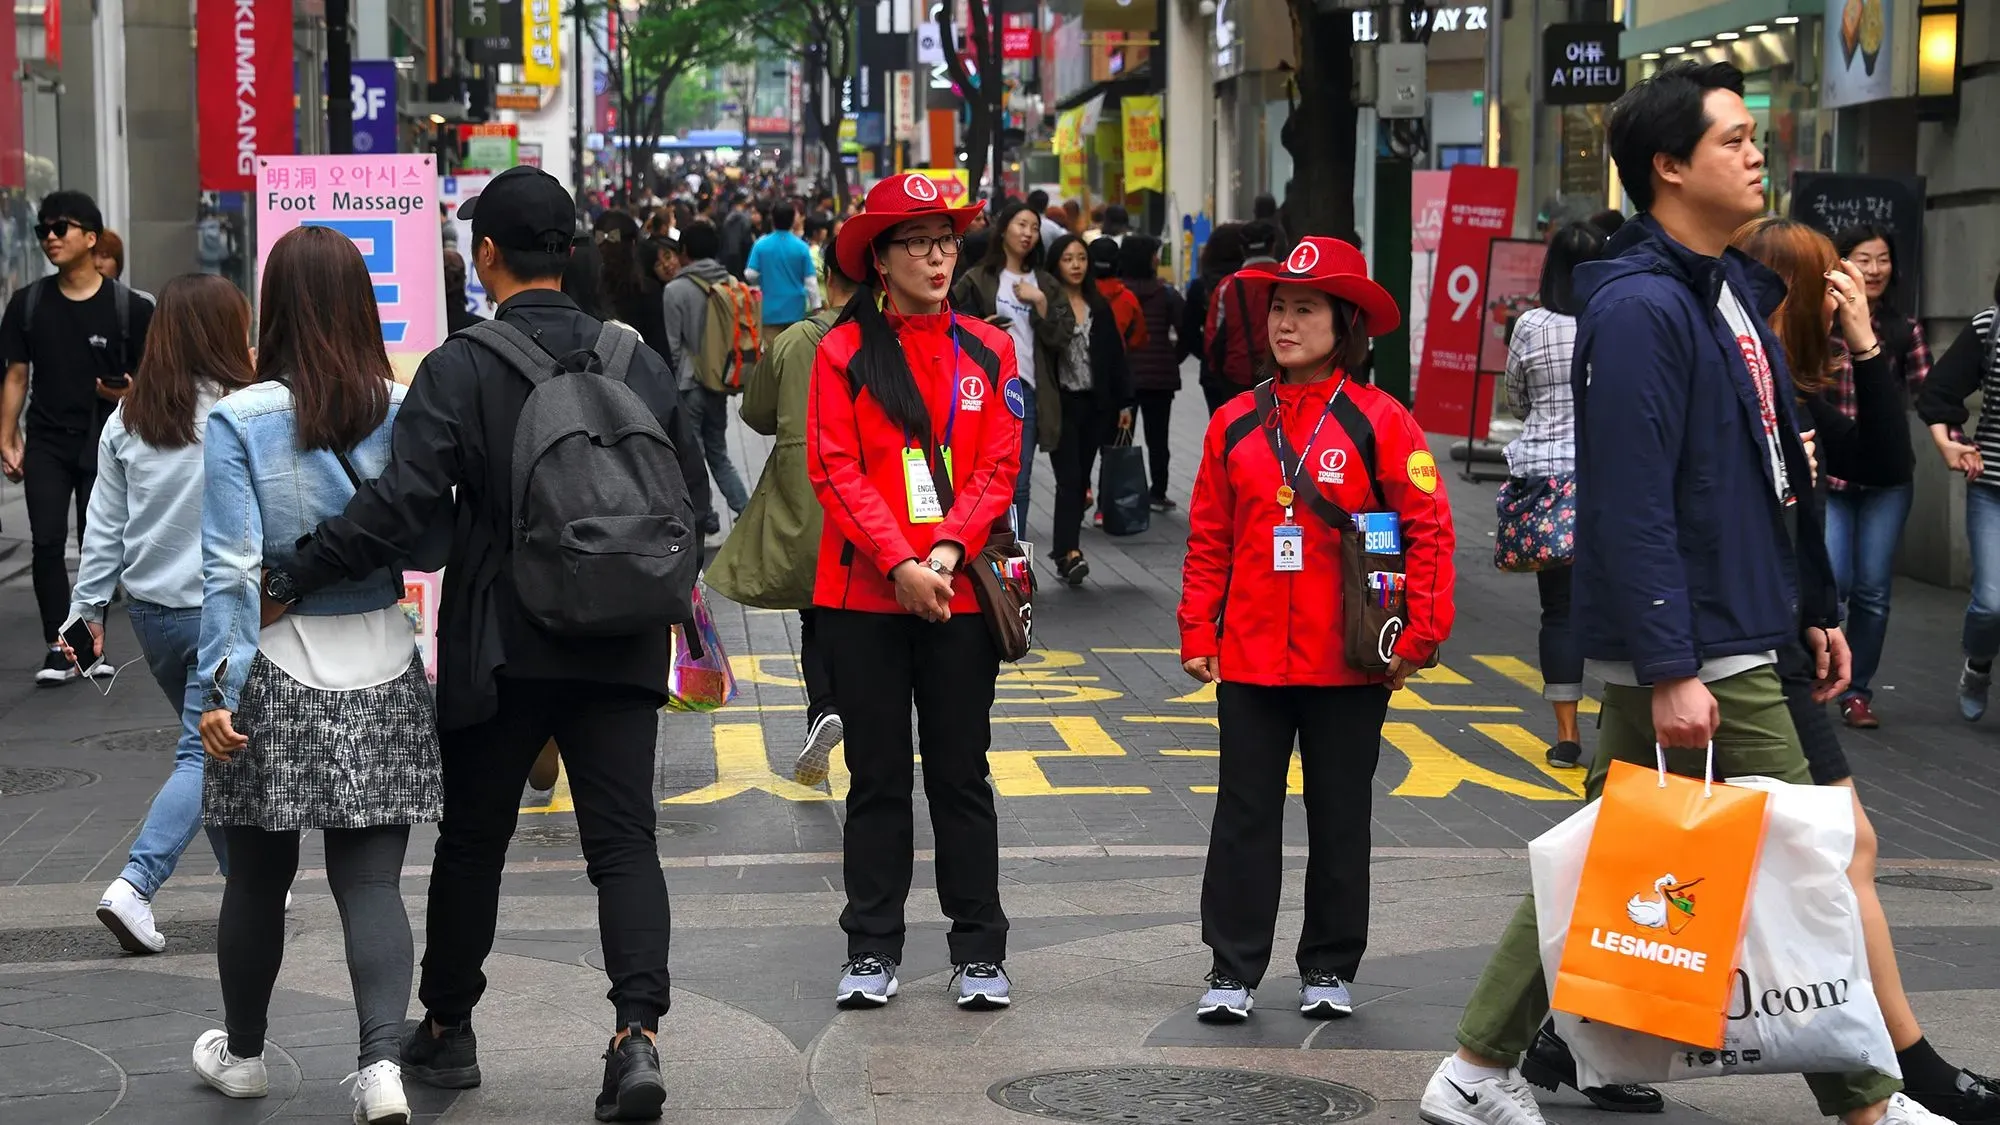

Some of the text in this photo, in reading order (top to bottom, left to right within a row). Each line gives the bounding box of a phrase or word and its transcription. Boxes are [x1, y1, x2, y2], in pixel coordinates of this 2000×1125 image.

[1566, 42, 1605, 64] 어퓨
[235, 0, 257, 176] KUMKANG
[267, 166, 421, 190] 明洞 오아시스
[268, 192, 424, 214] Foot Massage
[1447, 265, 1479, 321] 9
[1590, 927, 1708, 973] LESMORE
